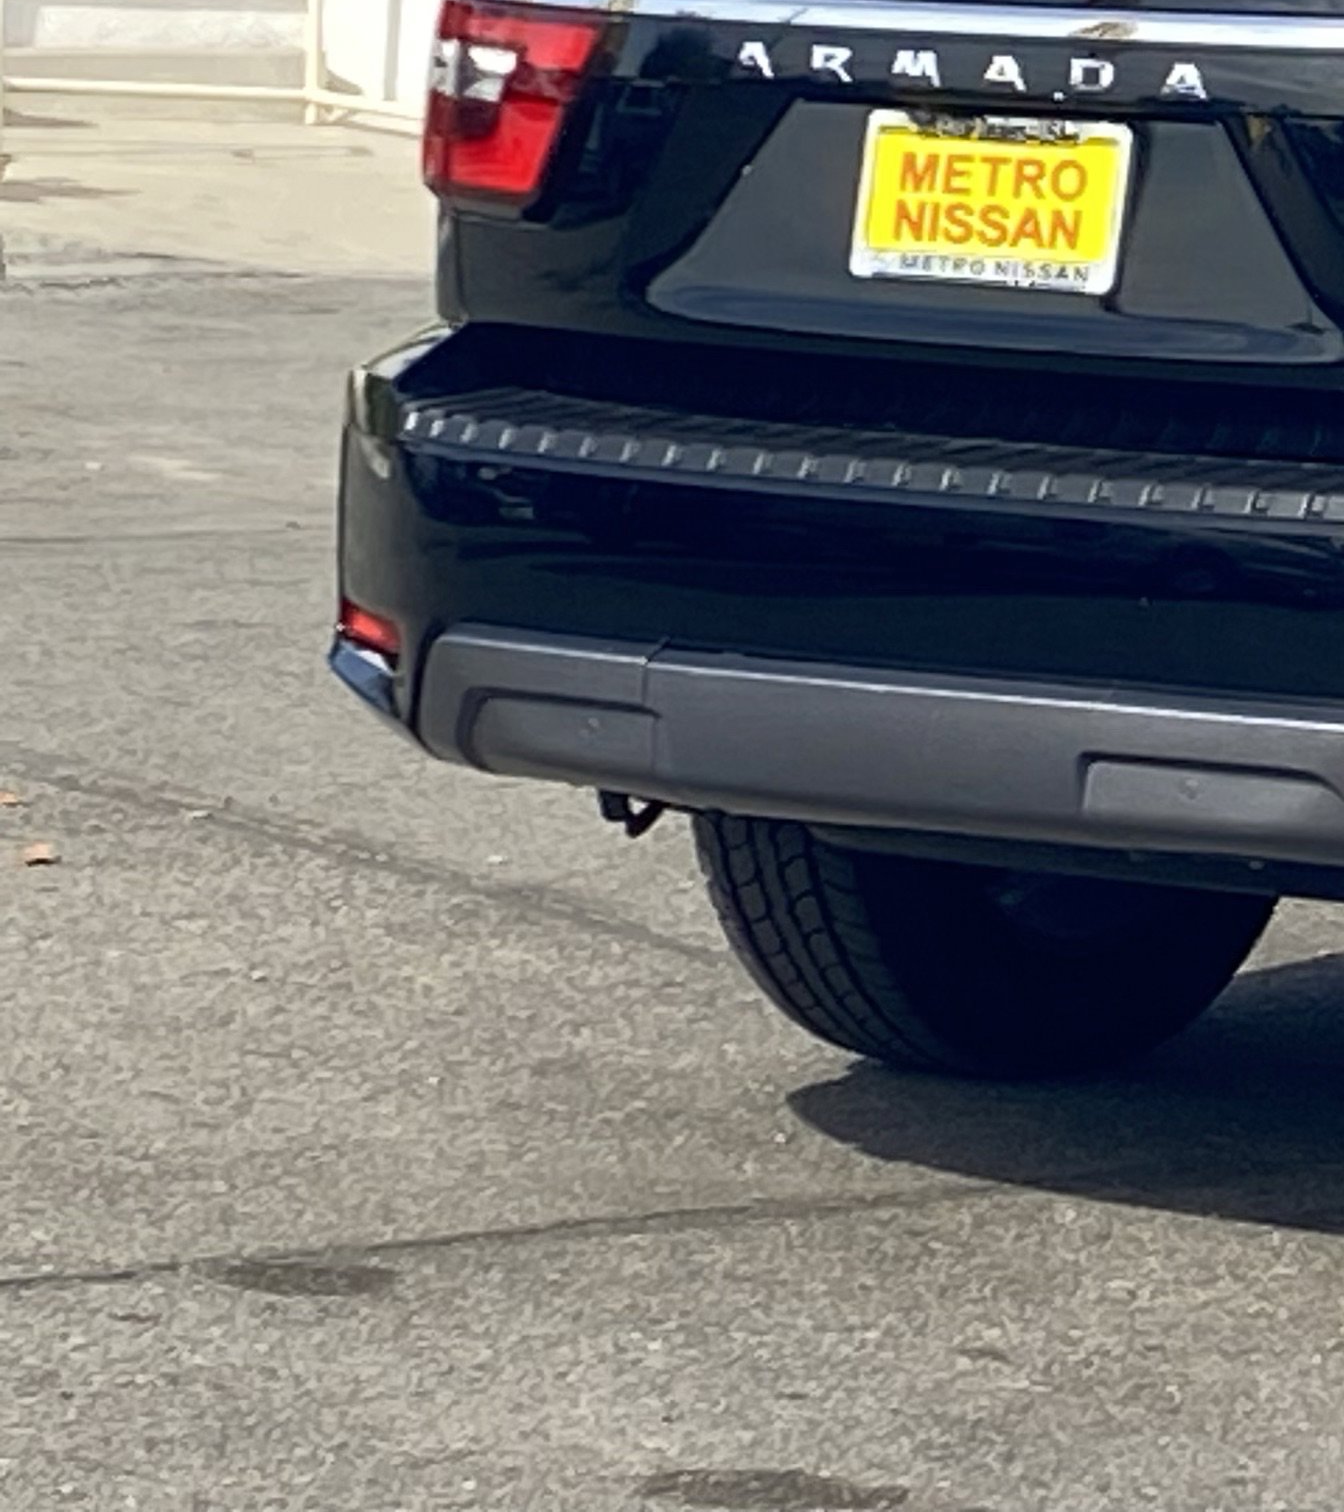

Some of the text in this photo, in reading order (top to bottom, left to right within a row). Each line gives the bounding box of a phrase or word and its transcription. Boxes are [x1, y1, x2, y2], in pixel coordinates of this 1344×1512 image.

[736, 40, 1209, 100] ARMADA
[899, 150, 1088, 202] METRO
[892, 199, 1082, 250] NISSAN
[899, 252, 1089, 283] METRO NISSAN
